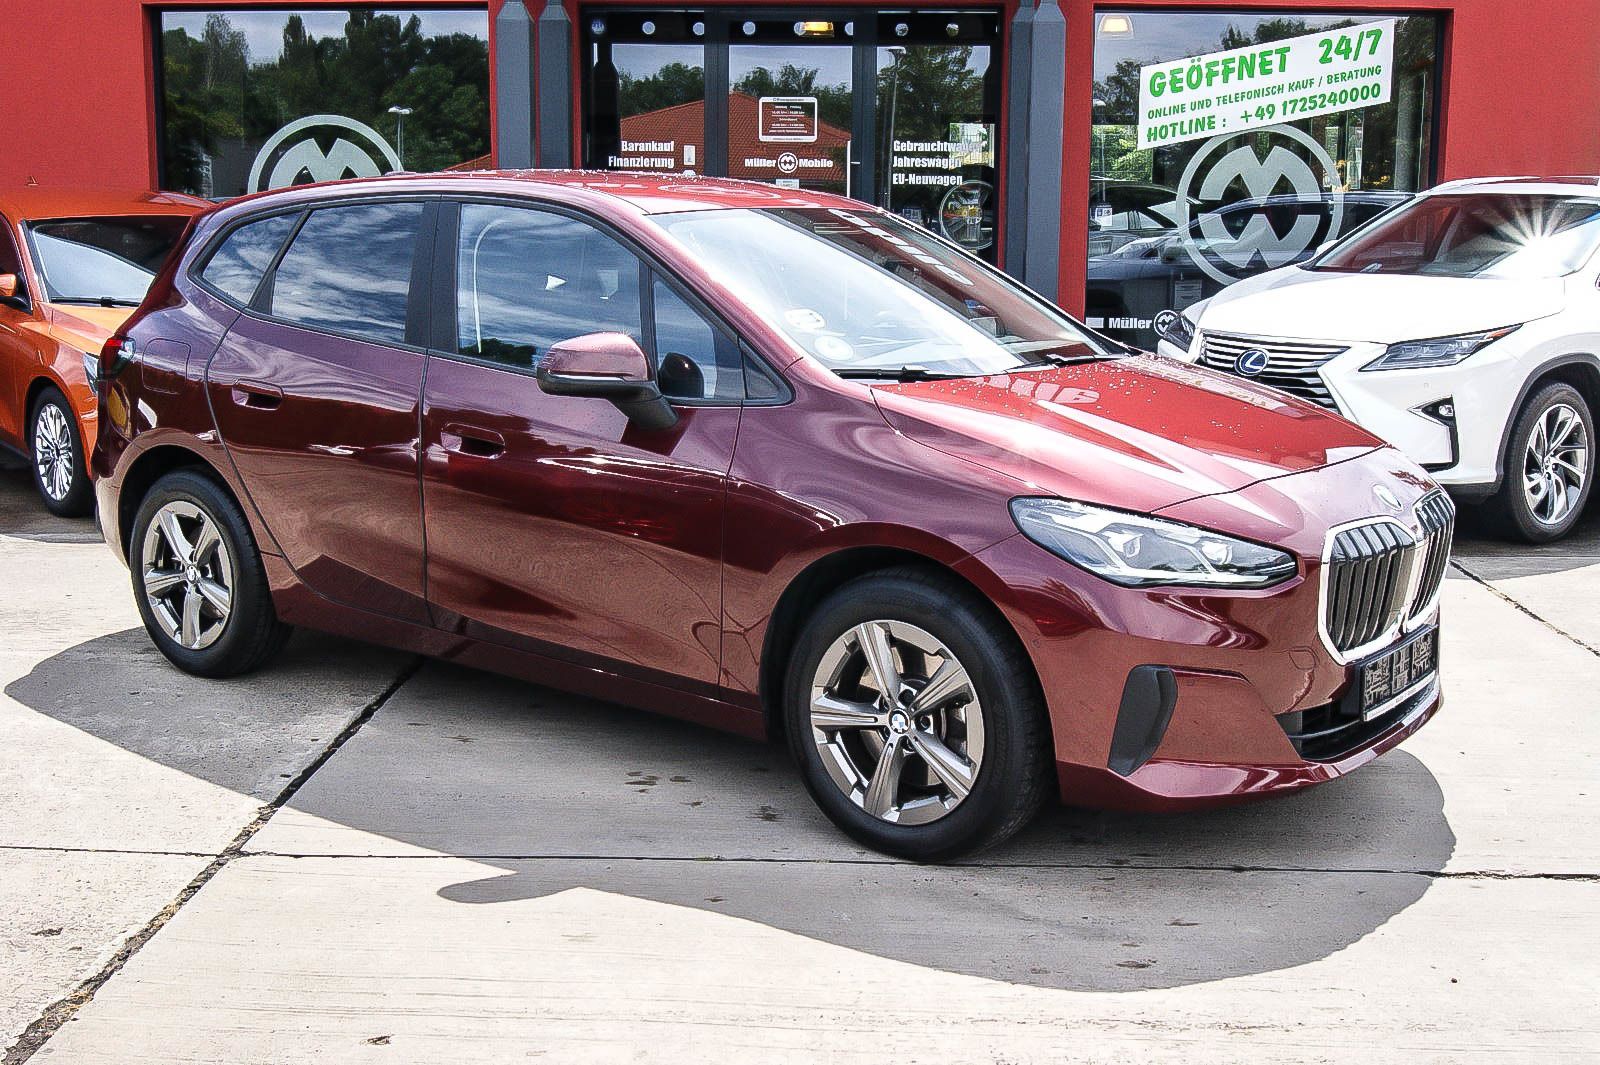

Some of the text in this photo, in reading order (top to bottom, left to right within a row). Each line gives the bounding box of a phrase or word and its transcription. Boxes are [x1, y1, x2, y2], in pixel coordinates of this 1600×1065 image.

[1149, 28, 1383, 97] GEÖFFNET 24/7
[1147, 103, 1186, 119] ONLINE
[1190, 98, 1212, 112] UND
[1215, 83, 1284, 106] TELEFONISCH
[1288, 78, 1315, 93] KAUF
[1326, 65, 1382, 84] BERATUNG
[1146, 115, 1216, 142] HOTLINE
[1240, 103, 1276, 123] +49
[1281, 83, 1381, 116] 1725240000
[621, 140, 675, 152] Barankauf
[608, 156, 675, 169] Finanzierung
[744, 158, 834, 168] Müller Mobile
[892, 156, 962, 169] Jahreswagen
[892, 173, 963, 186] EU-Neuwagen
[1108, 317, 1153, 329] Müller
